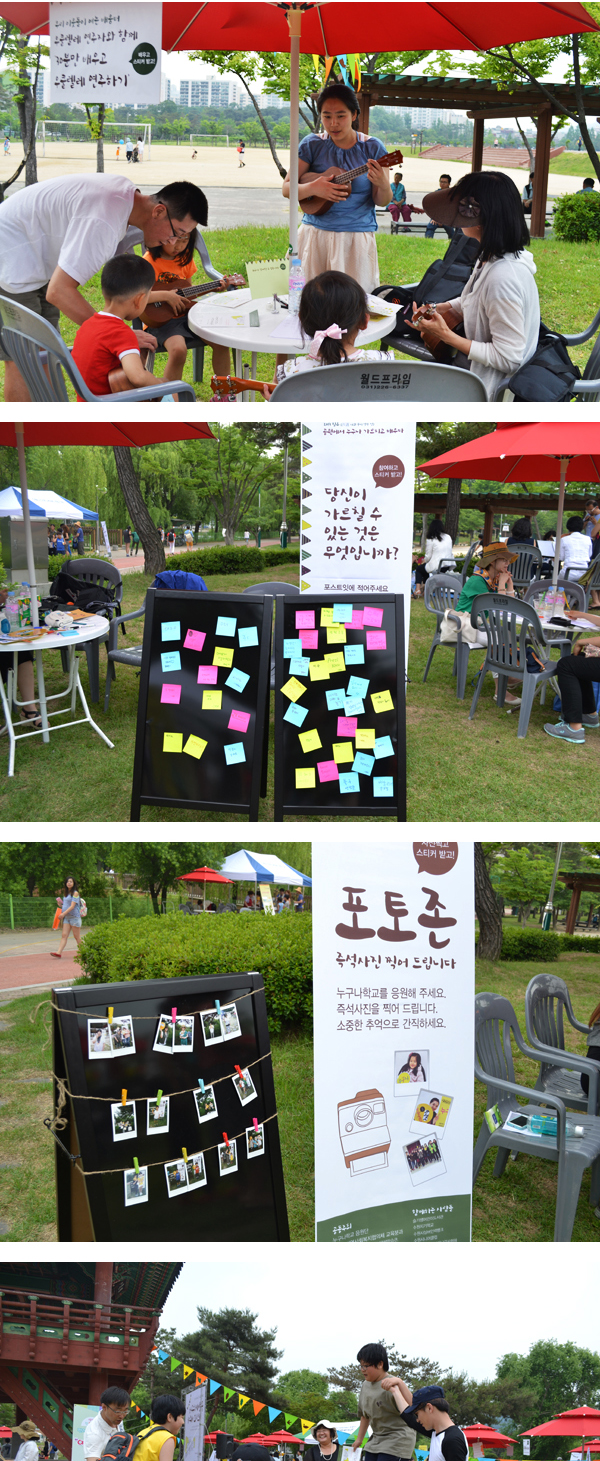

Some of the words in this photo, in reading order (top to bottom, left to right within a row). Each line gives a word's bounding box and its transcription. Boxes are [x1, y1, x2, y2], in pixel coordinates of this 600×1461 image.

[54, 33, 81, 46] 우쿨렐레
[84, 31, 115, 45] 연주자와
[118, 29, 138, 43] 함께
[54, 52, 80, 68] 30분만
[82, 52, 108, 66] 배우고
[54, 73, 86, 89] 우쿨렐레
[360, 373, 411, 385] 월드프라임
[324, 487, 366, 502] 당신이
[324, 506, 365, 522] 가르칠
[370, 506, 382, 521] 수
[324, 526, 349, 541] 있는
[354, 526, 380, 541] 것은
[323, 545, 399, 560] 무엇입니까?
[324, 583, 355, 591] 포스트잇에
[357, 584, 389, 592] 적어주세요
[416, 849, 437, 858] 스티커
[438, 850, 455, 860] 받고!
[335, 886, 457, 949] 포토존
[336, 951, 382, 969] 즉석사진
[385, 955, 408, 969] 찍어
[412, 956, 456, 970] 드립니다
[336, 987, 388, 999] 누구나학교를
[391, 987, 416, 999] 응원해
[419, 987, 446, 999] 주세요.
[336, 1003, 380, 1015] 즉석사진을
[383, 1003, 400, 1015] 찍어
[402, 1003, 438, 1014] 드립니다.
[336, 1019, 363, 1032] 소중한
[365, 1018, 400, 1030] 추억으로
[402, 1017, 446, 1029] 간직하세요.
